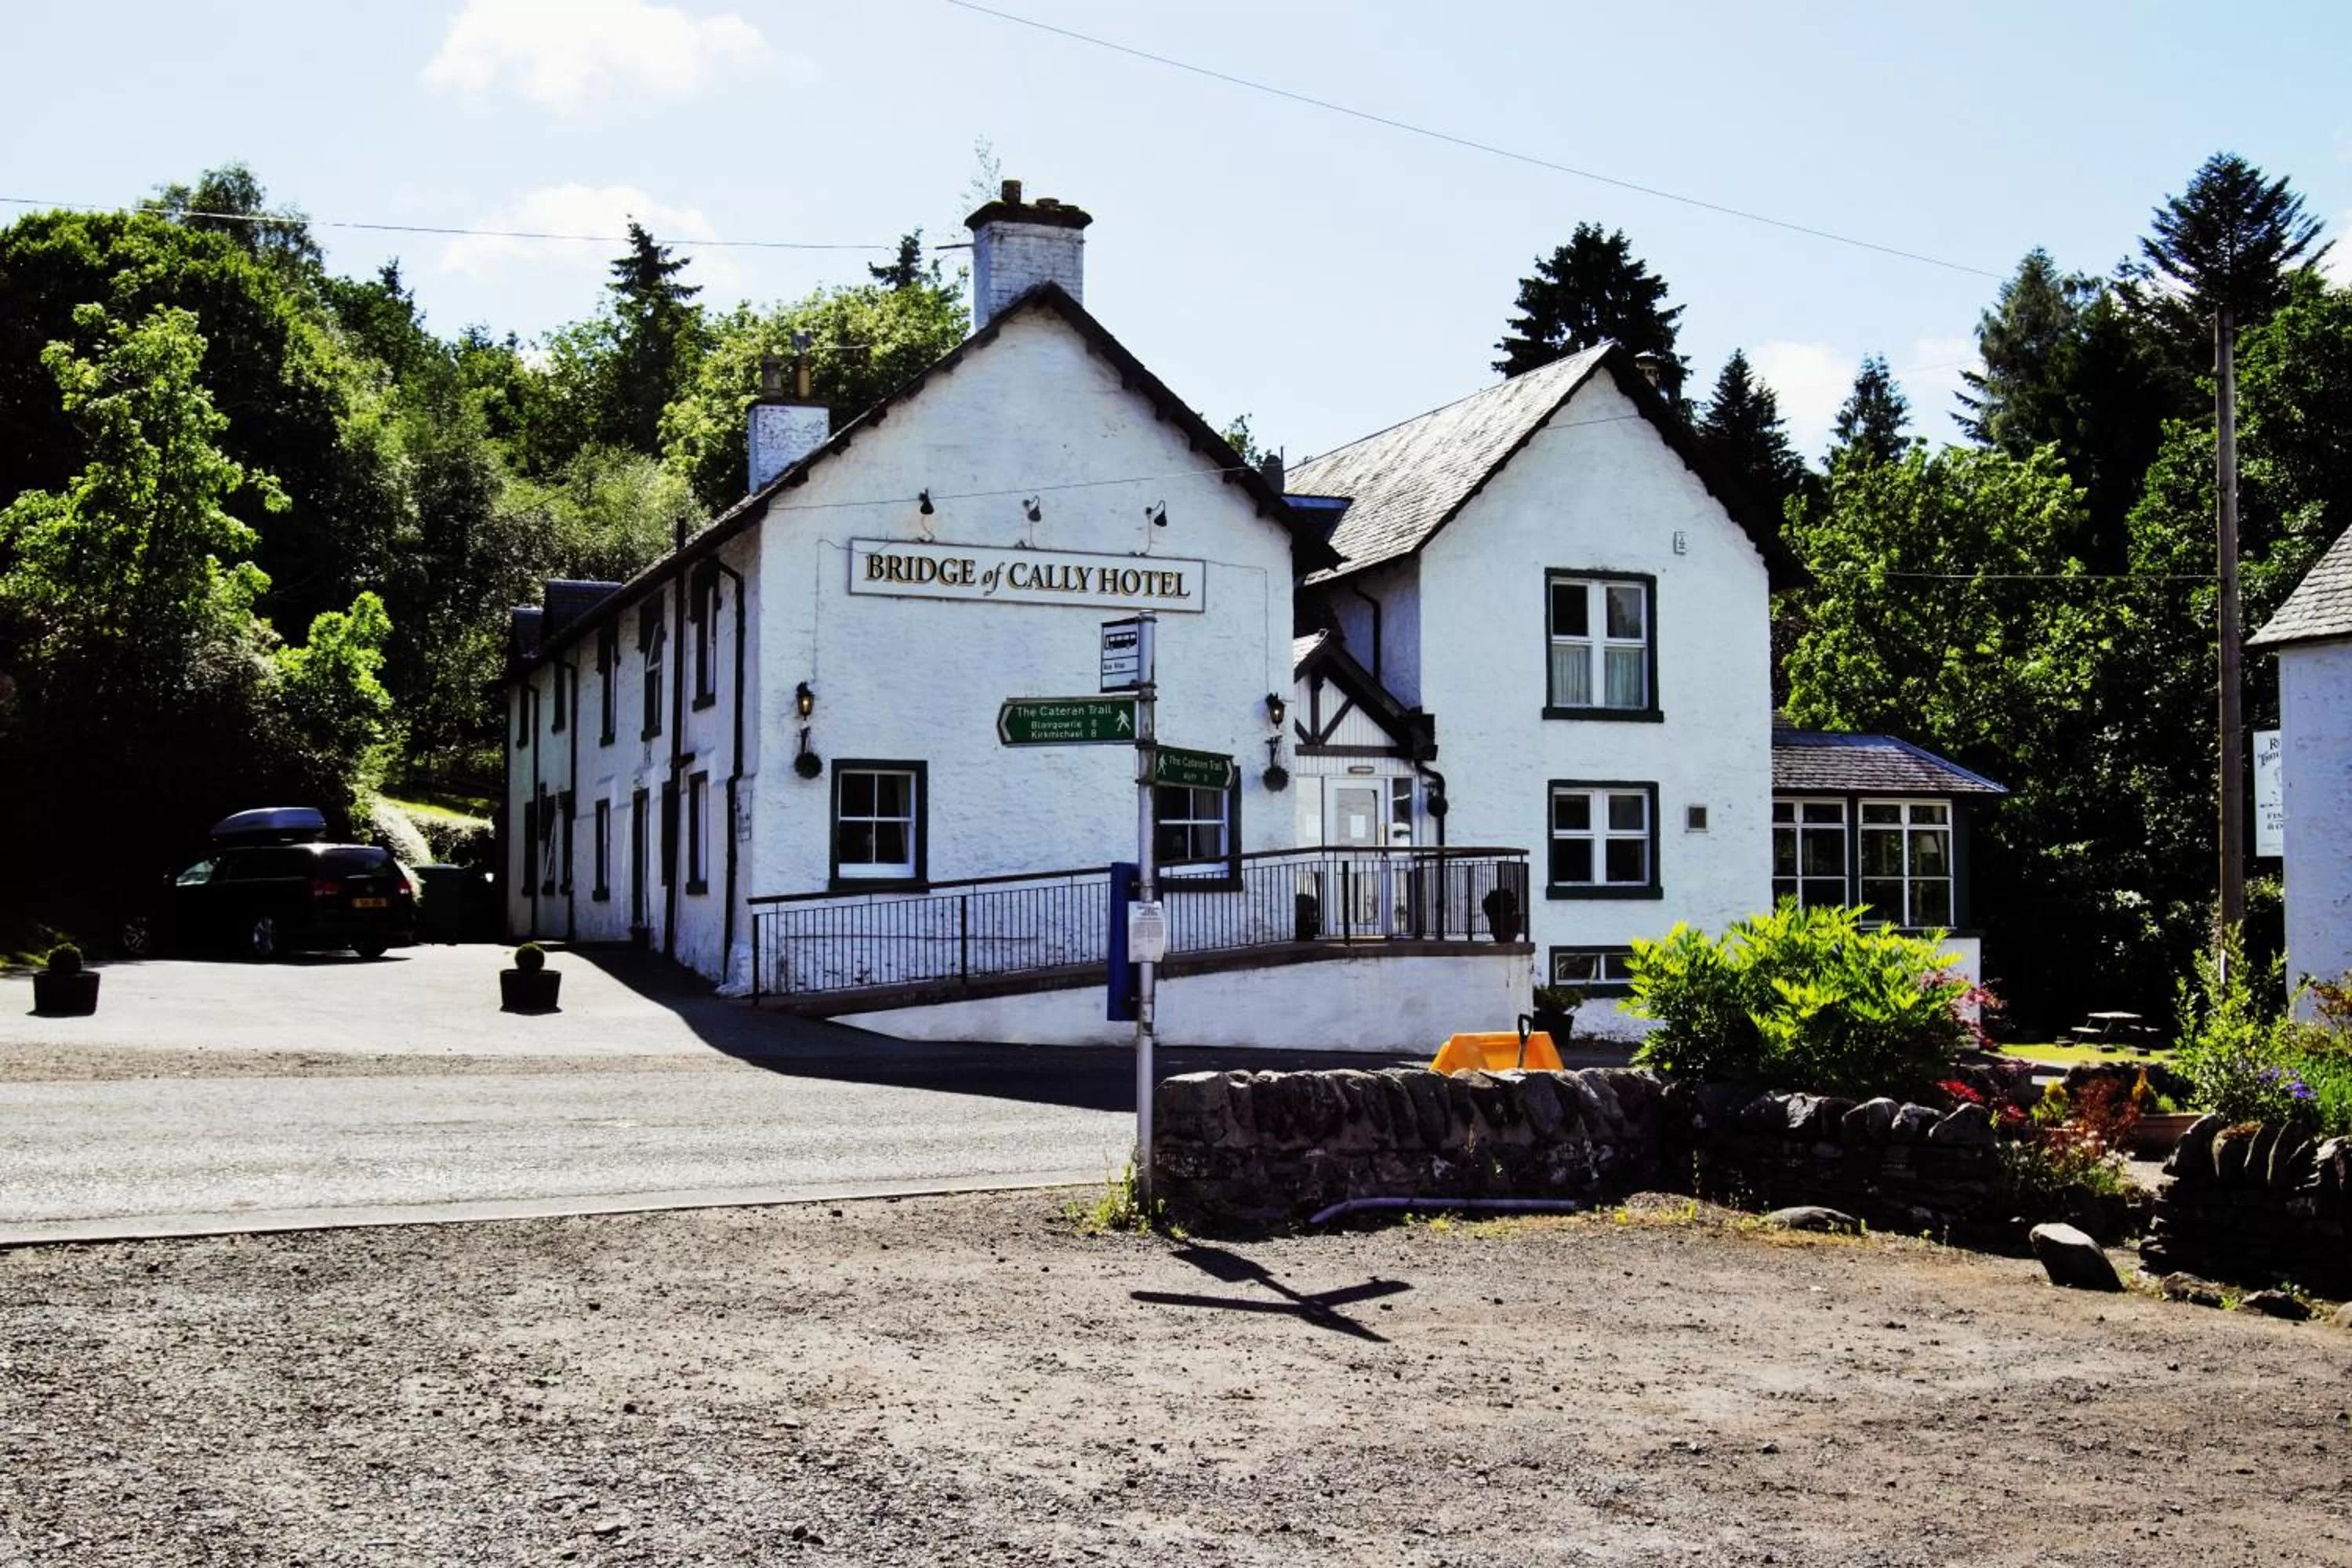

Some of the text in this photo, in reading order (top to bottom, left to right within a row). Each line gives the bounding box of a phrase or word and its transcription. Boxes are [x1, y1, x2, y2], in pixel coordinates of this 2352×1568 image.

[866, 553, 1191, 599] BRIDGE of CALLY HOTEL
[1016, 704, 1113, 718] The Cateran Trail
[1091, 728, 1097, 738] 8
